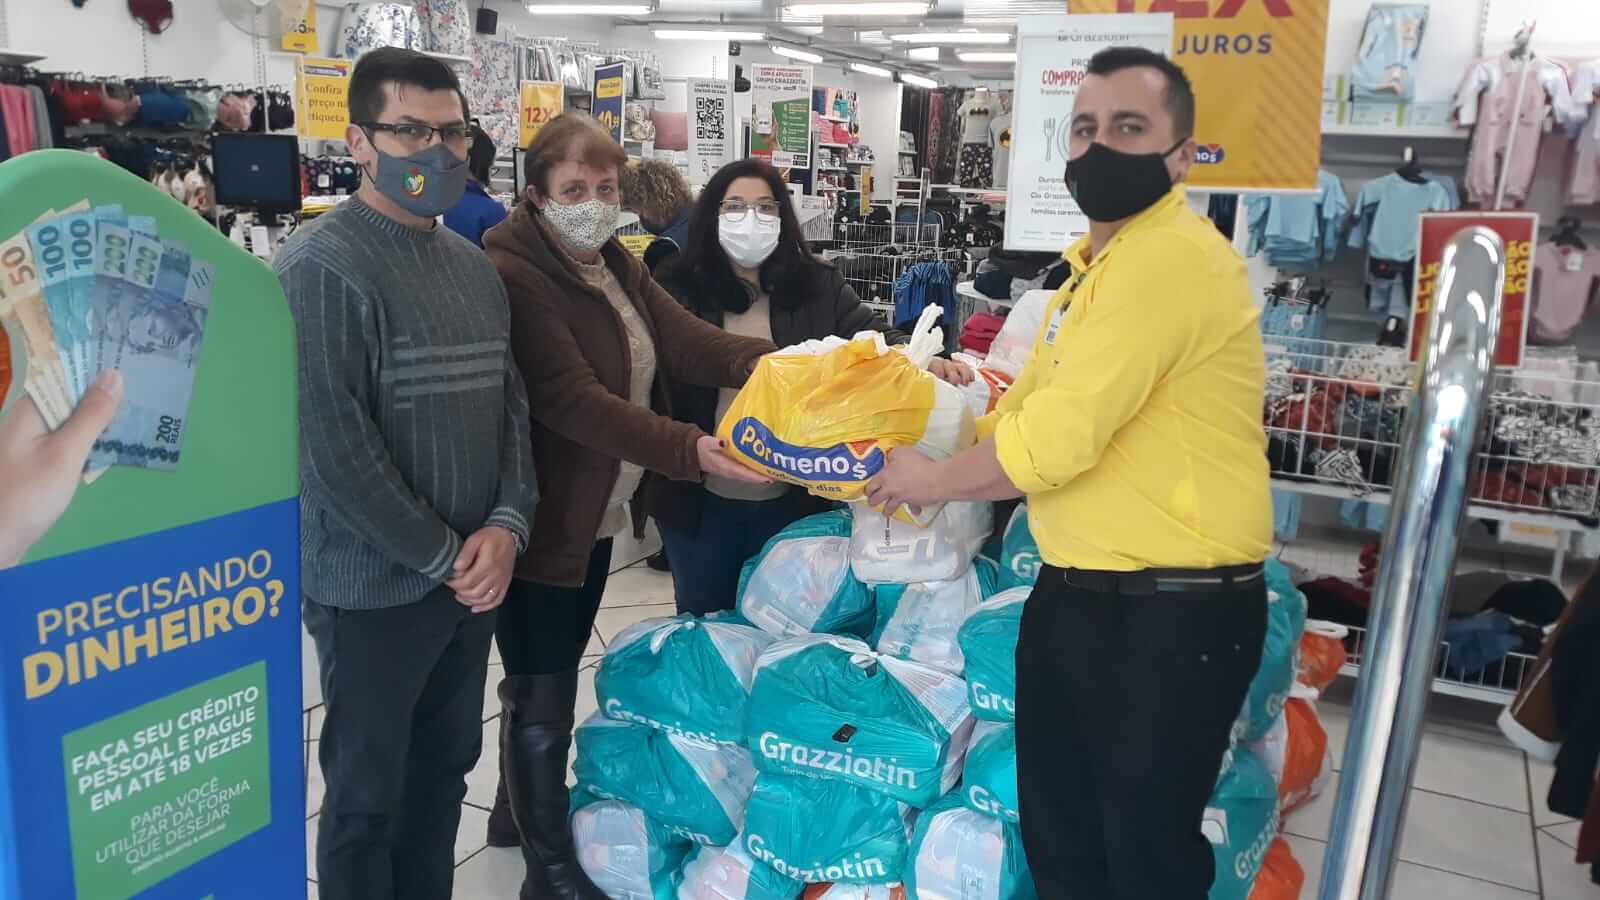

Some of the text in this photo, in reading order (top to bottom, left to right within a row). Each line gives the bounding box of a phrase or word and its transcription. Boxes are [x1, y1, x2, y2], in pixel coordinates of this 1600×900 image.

[1176, 33, 1273, 55] JUROS
[1, 245, 35, 287] 50
[38, 225, 65, 279] 100
[69, 219, 94, 271] 100
[104, 234, 127, 276] 200
[156, 415, 174, 444] 200
[36, 549, 273, 645] PRECISANDO
[22, 579, 285, 700] DINHEIRO?
[71, 685, 259, 776] FAÇA SEU CRÉDITO
[78, 705, 257, 795] PESSOAL E PAGUE
[89, 727, 253, 813] EM ATÉ 18 VEZES
[759, 731, 917, 790] Grazziotin
[95, 818, 168, 864] UTILIZAR
[172, 807, 194, 827] DA
[198, 779, 251, 814] FORMA
[130, 776, 219, 832] PARA VOCÊ
[125, 836, 161, 865] QUE
[165, 803, 231, 846] DESEJAR
[747, 833, 887, 883] Grazziotin
